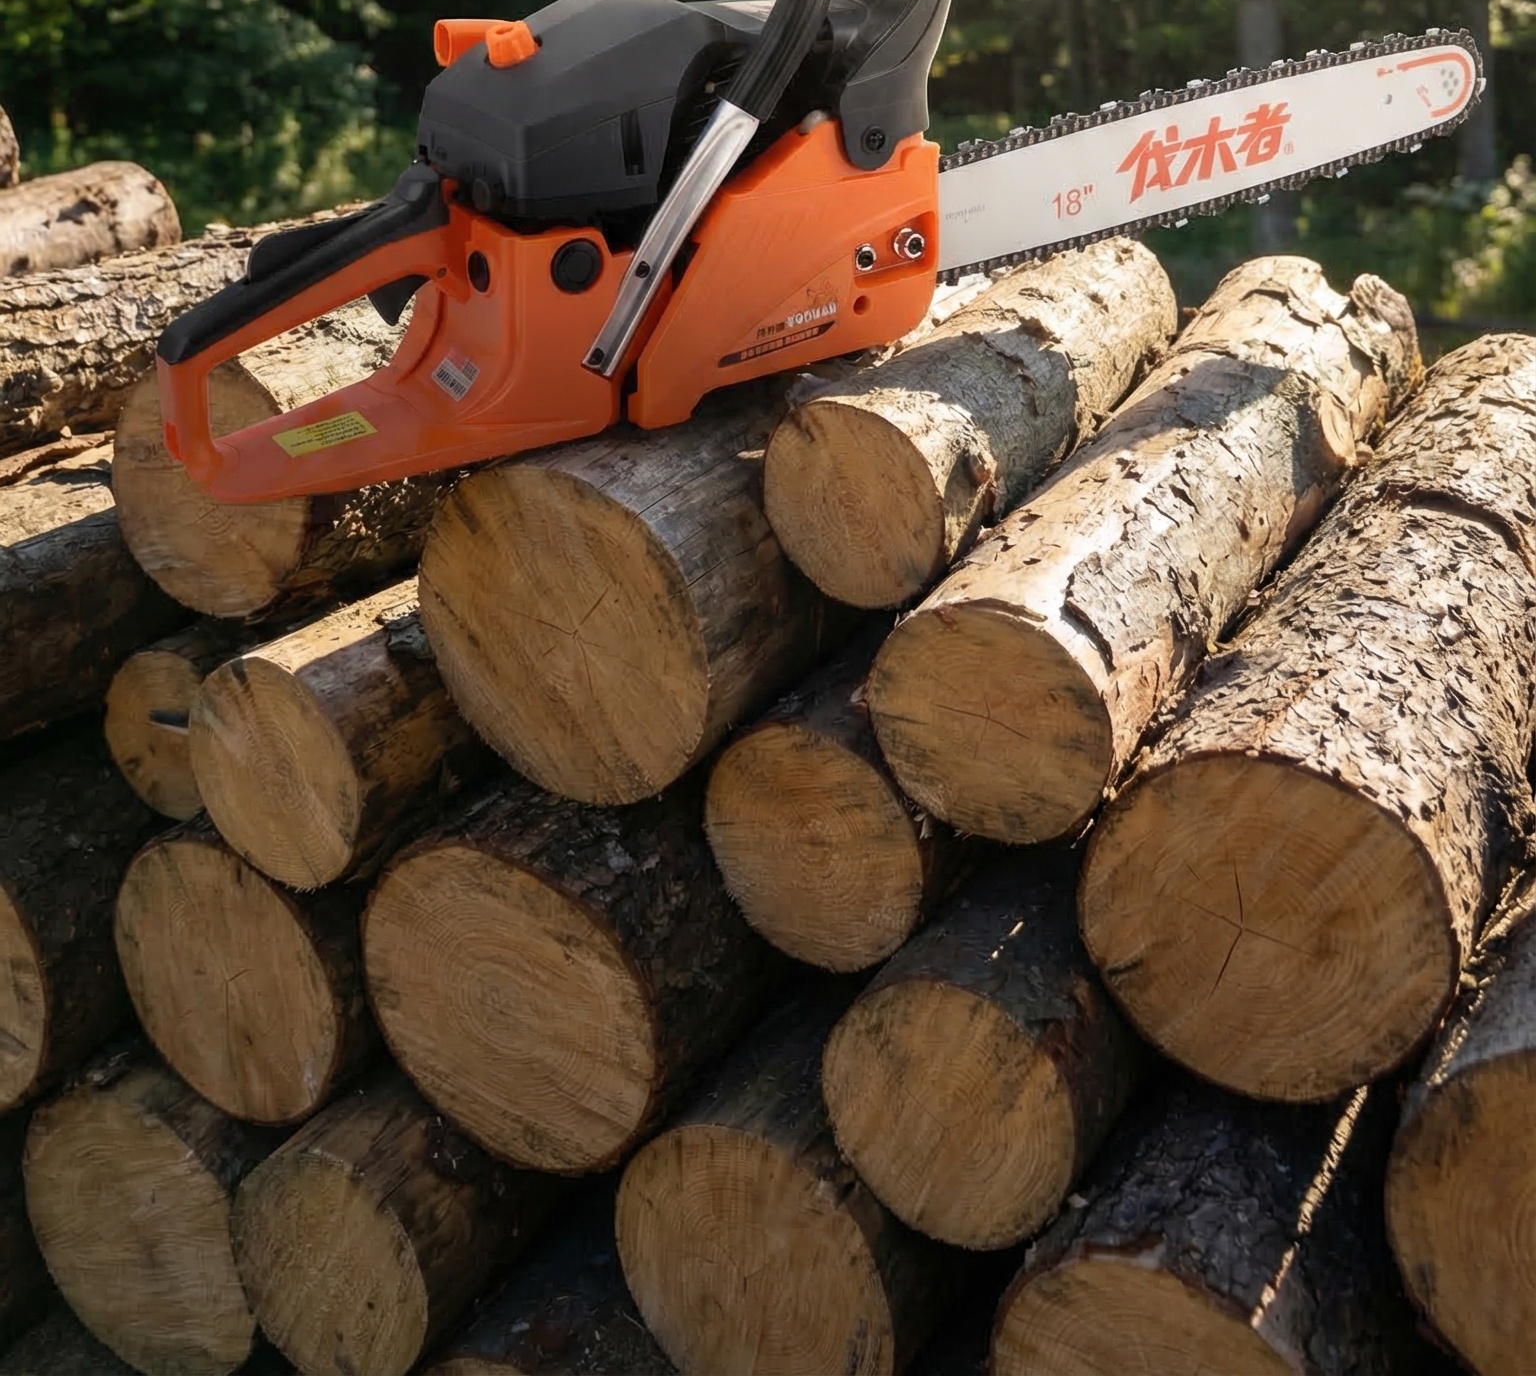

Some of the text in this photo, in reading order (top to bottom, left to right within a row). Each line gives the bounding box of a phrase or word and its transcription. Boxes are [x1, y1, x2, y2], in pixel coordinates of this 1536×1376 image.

[1116, 102, 1292, 203] 伐木者
[1052, 184, 1093, 220] 18"
